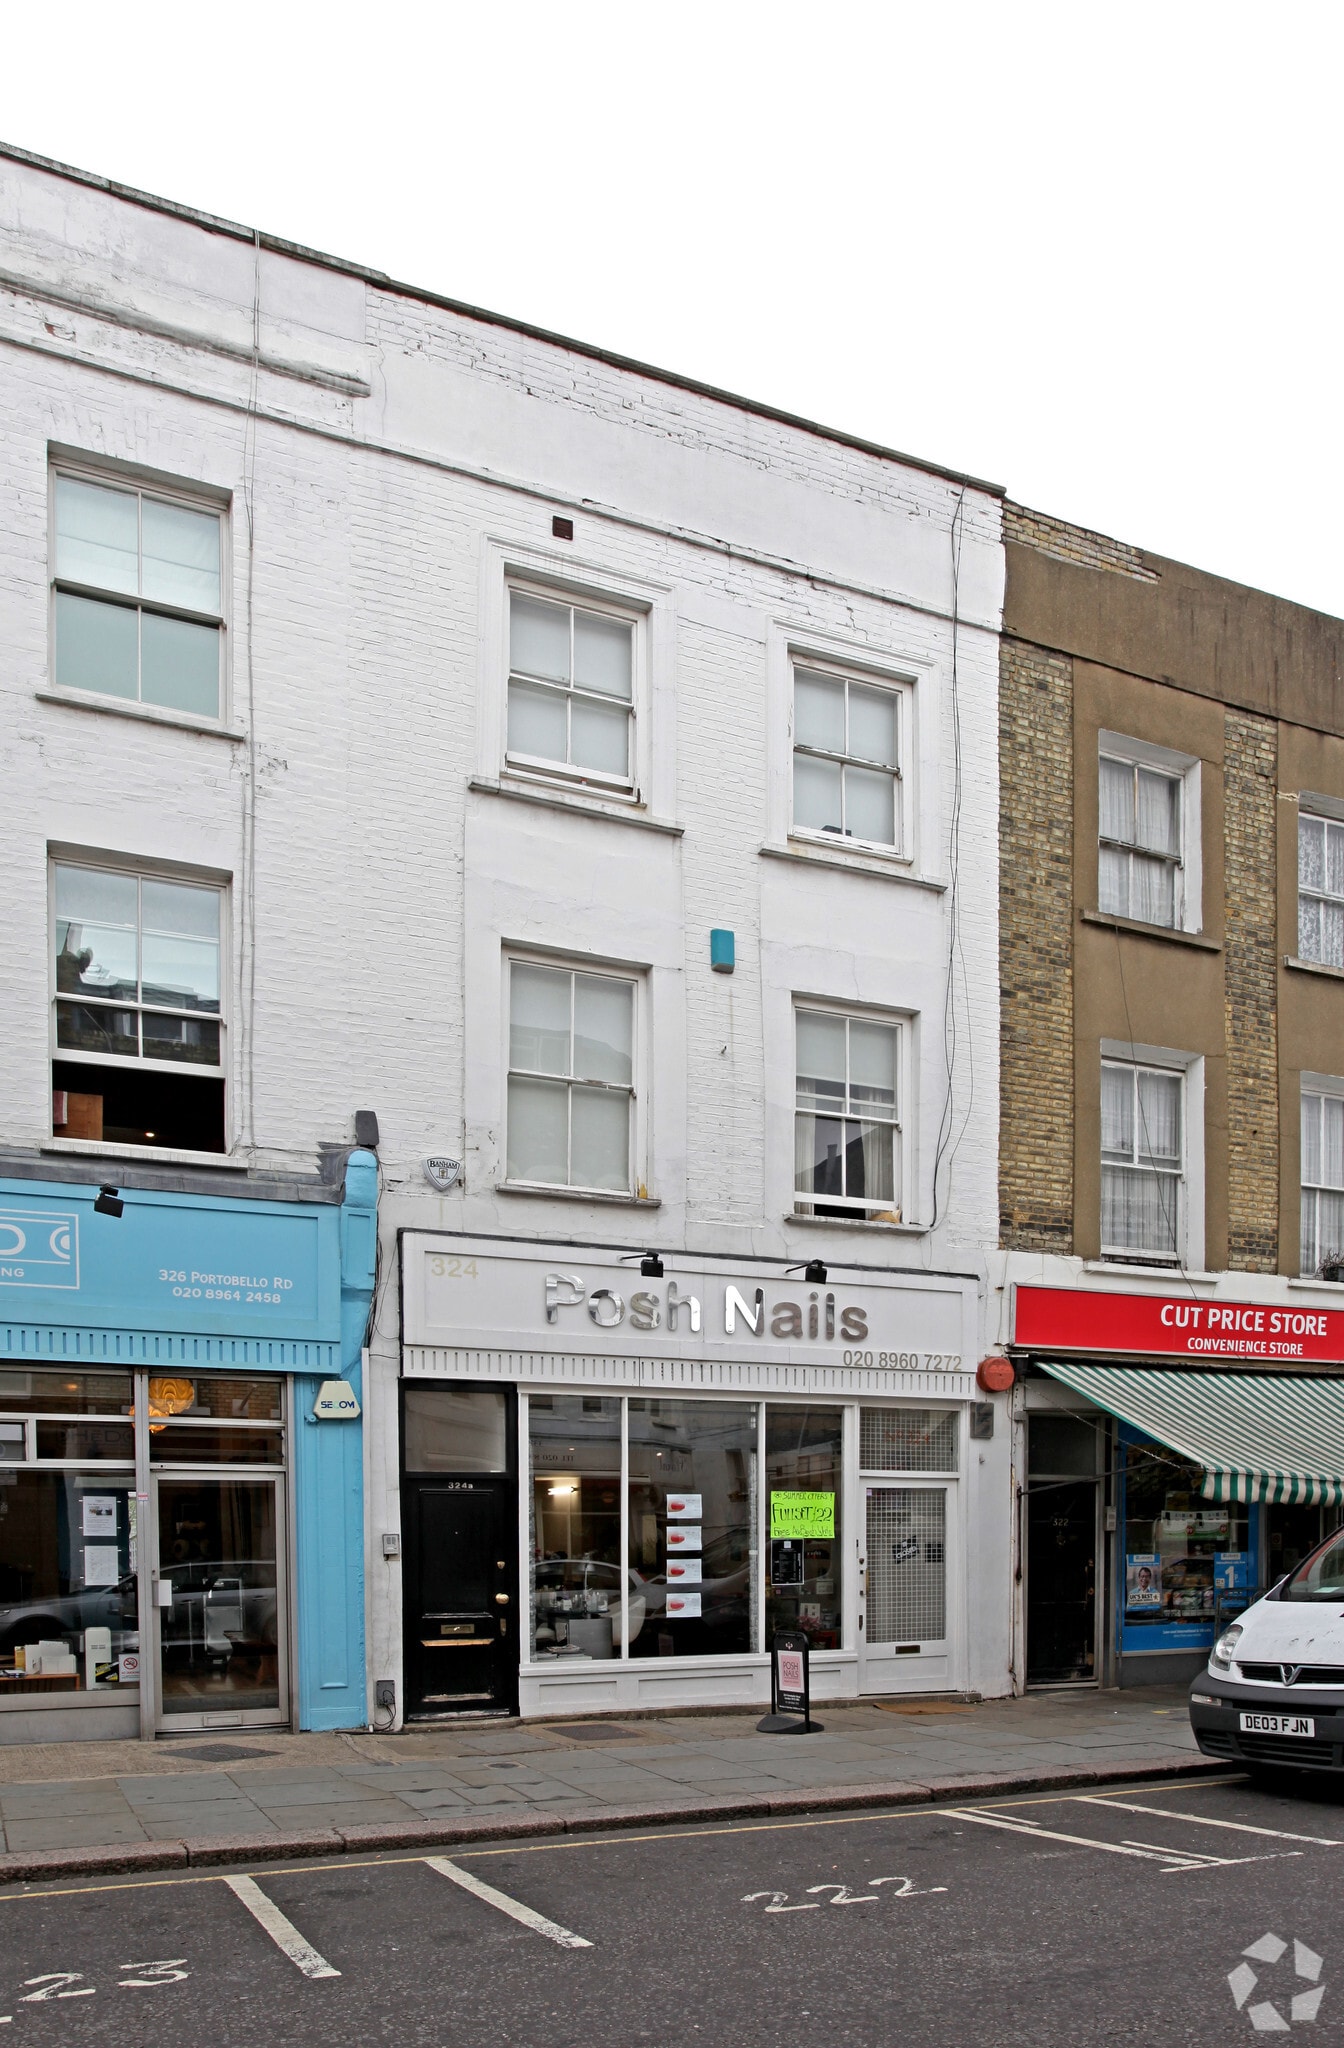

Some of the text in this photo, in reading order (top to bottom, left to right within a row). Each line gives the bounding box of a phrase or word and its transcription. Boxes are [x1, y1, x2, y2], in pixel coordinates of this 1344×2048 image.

[430, 1160, 457, 1169] BANHAM
[158, 1269, 187, 1282] 326
[431, 1257, 479, 1279] 324
[172, 1286, 281, 1304] 020 8964 2458
[546, 1273, 869, 1341] Posh Nails
[1160, 1304, 1327, 1337] CUT PRICE STORE
[1187, 1337, 1303, 1355] CONVENIENCE STORE
[843, 1350, 962, 1371] 020 8960 7272
[448, 1481, 474, 1489] 324a
[783, 1661, 799, 1671] POSH
[783, 1670, 799, 1678] NAILS
[1245, 1715, 1309, 1734] DE03 FJN
[740, 1877, 949, 1912] 222
[0, 1960, 191, 2024] 23
